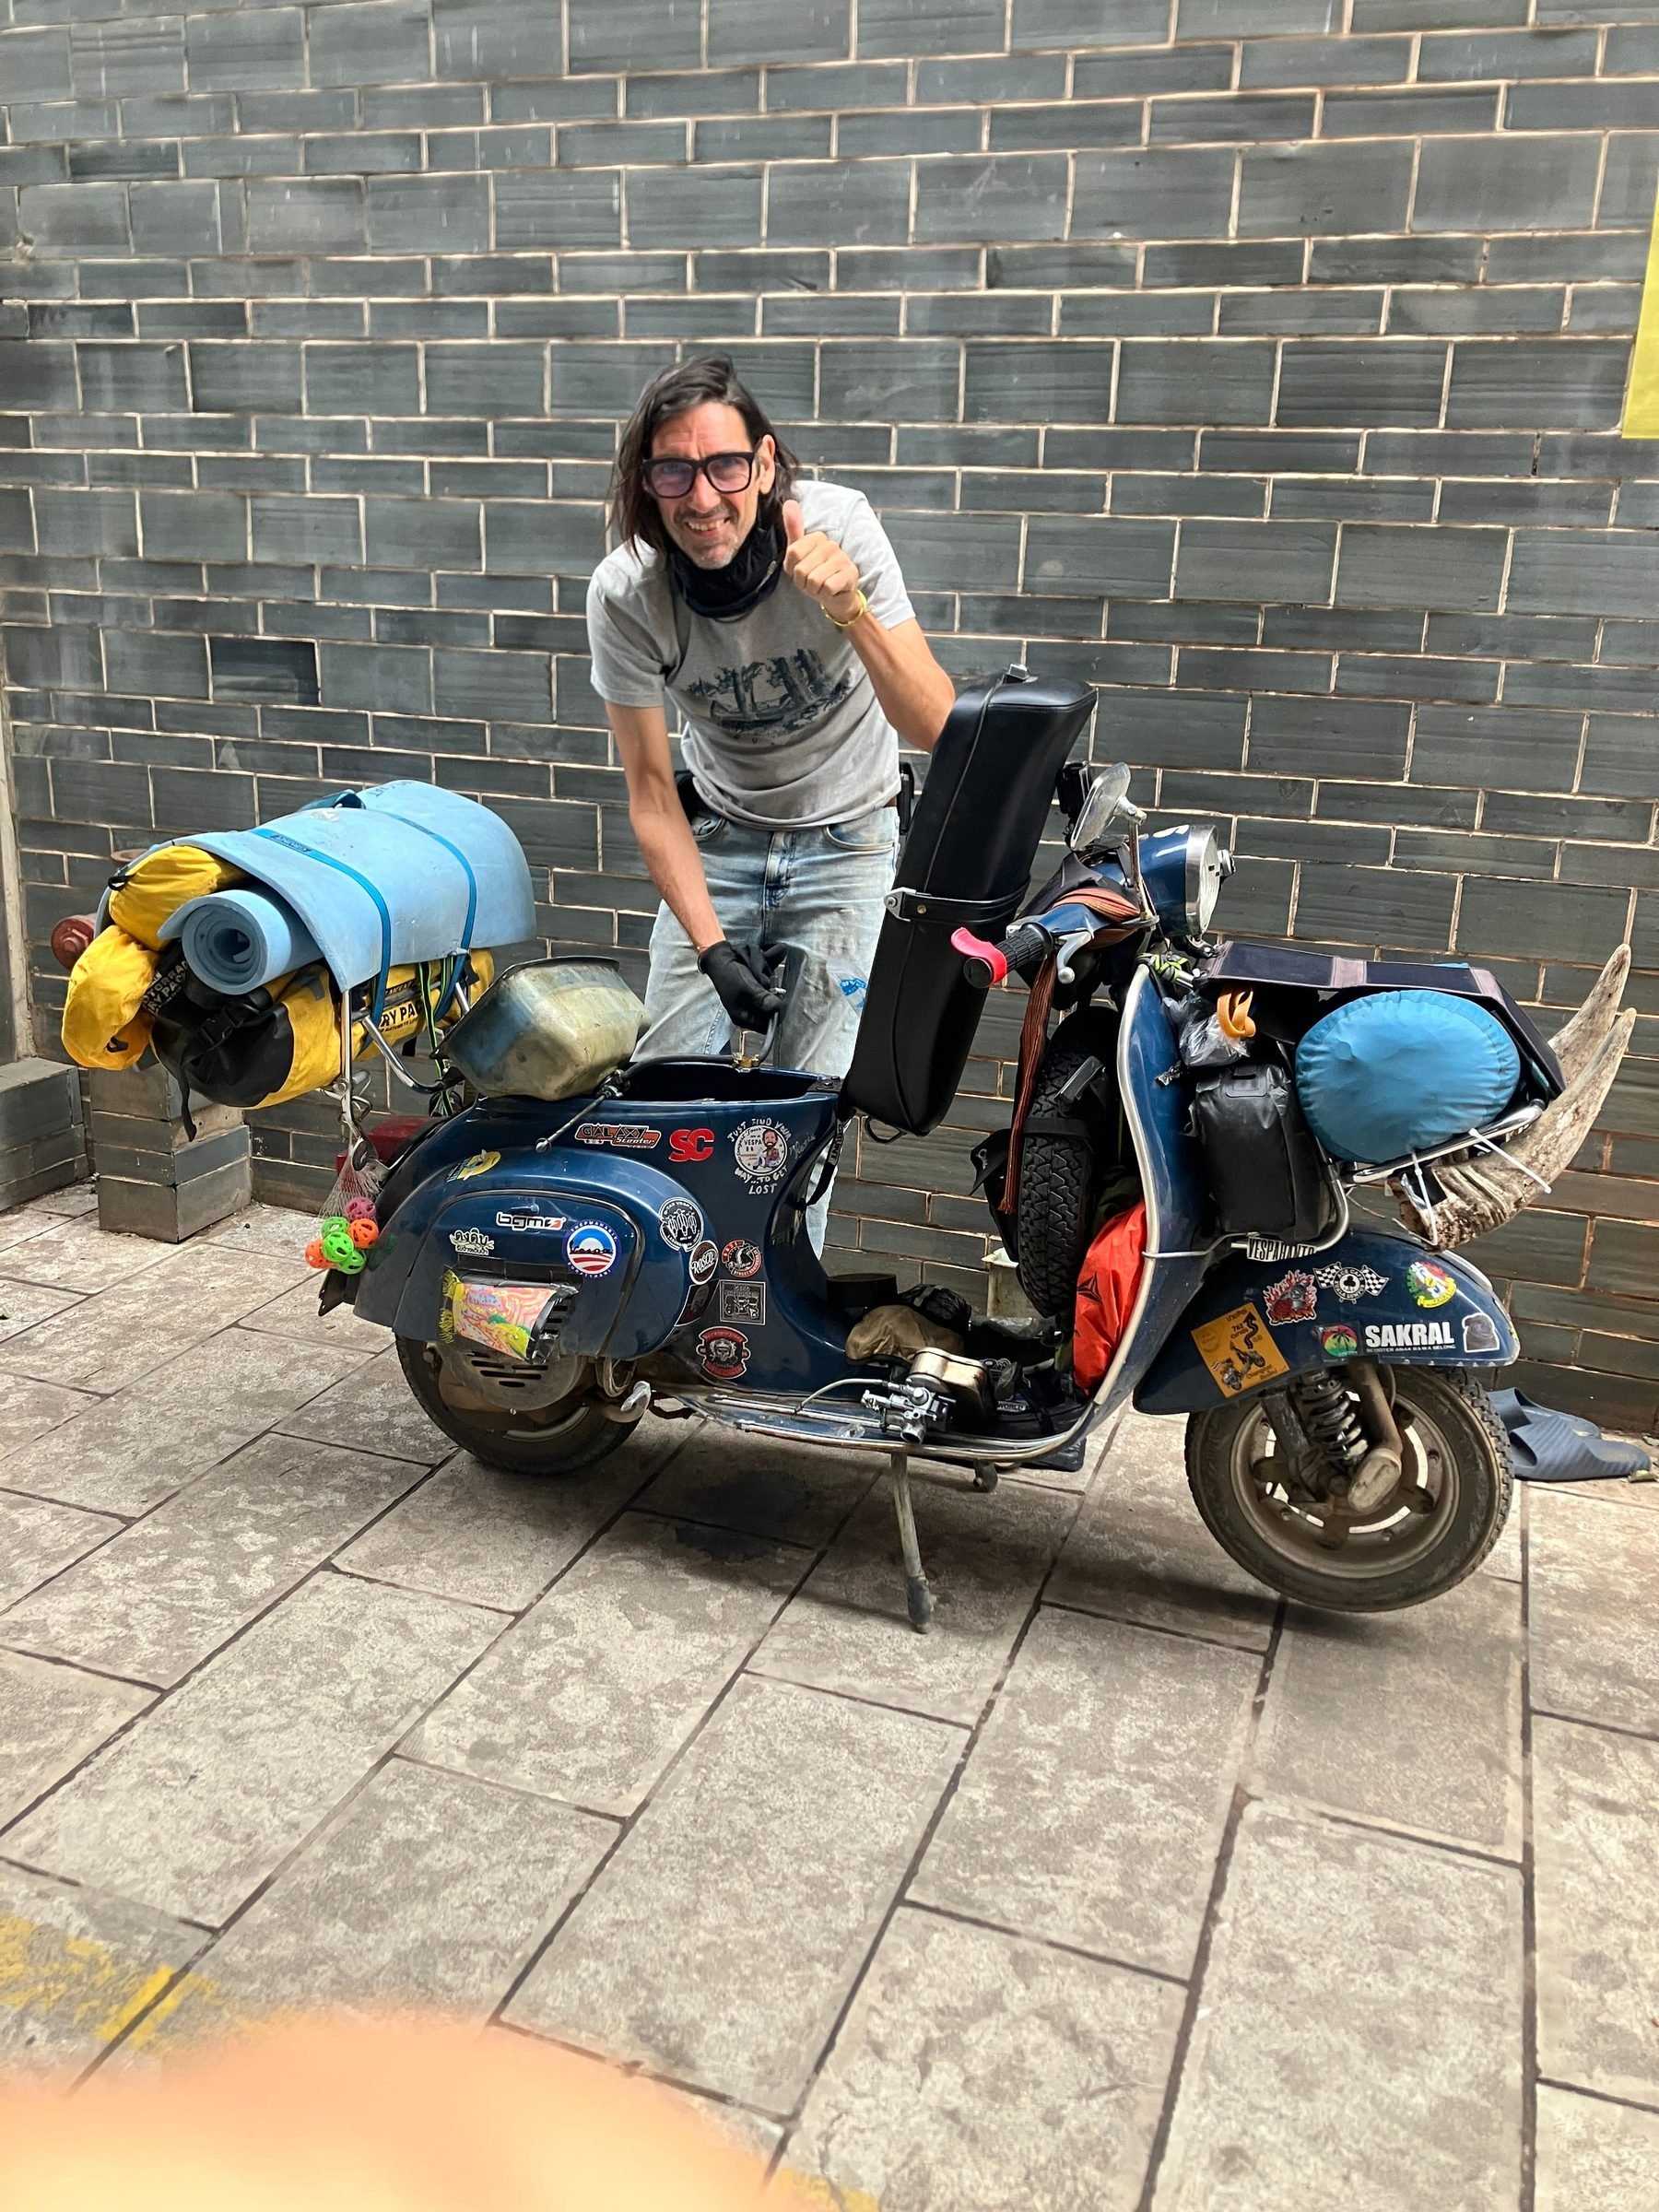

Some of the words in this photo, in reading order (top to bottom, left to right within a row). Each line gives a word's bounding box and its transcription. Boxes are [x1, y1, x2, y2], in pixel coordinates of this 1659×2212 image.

[142, 960, 188, 1005] OTORRAD
[399, 999, 423, 1022] PAC
[727, 1121, 747, 1142] JUST
[751, 1117, 772, 1126] FIND
[774, 1121, 792, 1142] YOUR
[668, 1127, 715, 1162] SC
[735, 1167, 752, 1183] WAY
[772, 1165, 788, 1181] GET
[748, 1183, 778, 1195] LOST
[1365, 1321, 1455, 1348] SAKRAL
